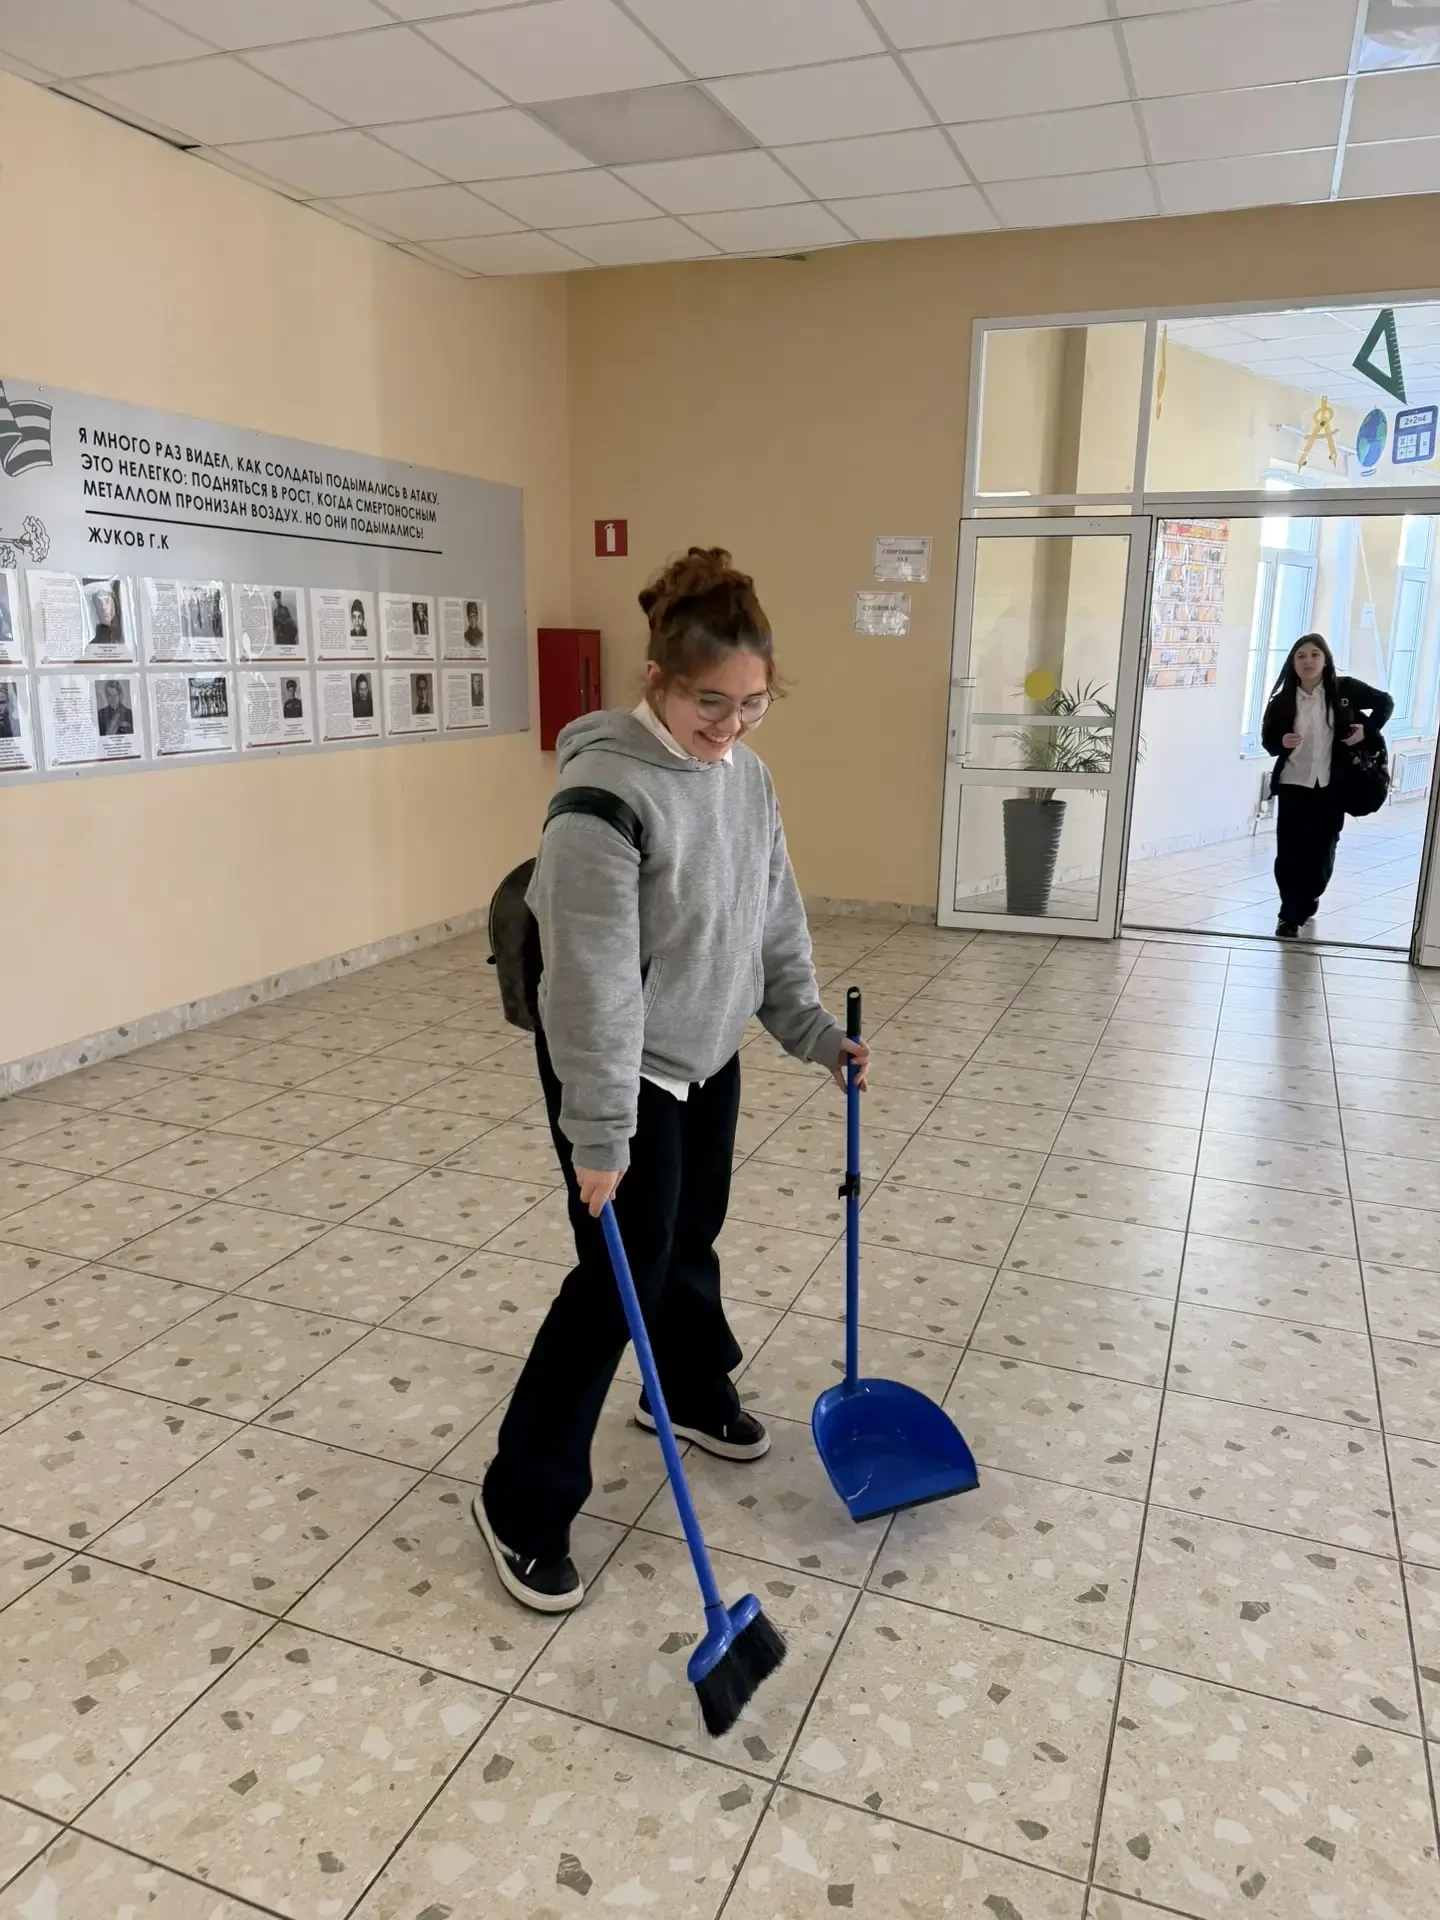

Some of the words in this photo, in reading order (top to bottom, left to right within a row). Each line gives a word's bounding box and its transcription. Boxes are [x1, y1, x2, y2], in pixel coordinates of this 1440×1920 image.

[1404, 415, 1426, 425] 2+2=4
[79, 427, 87, 444] Я
[93, 430, 150, 455] МНОГО
[156, 441, 182, 460] РАЗ
[186, 447, 233, 471] ВИДЕЛ,
[237, 457, 261, 475] КАК
[265, 462, 323, 485] СОЛДАТЫ
[326, 473, 400, 497] ПОДЫМАЛИСЬ
[402, 487, 408, 499] В
[81, 453, 113, 473] ЭТО
[119, 459, 188, 485] НЕЛЕГКО:
[192, 472, 268, 497] ПОДНЯТЬСЯ
[271, 485, 278, 499] В
[281, 487, 314, 506] РОСТ,
[317, 492, 353, 510] КОГДА
[356, 499, 437, 523] СМЕРТОНОСНЫМ
[83, 479, 172, 506] МЕТАЛЛОМ
[176, 492, 247, 516] ПРОНИЗАН
[251, 504, 302, 524] ВОЗДУХ.
[305, 511, 322, 526] НО
[325, 514, 348, 529] ОНИ
[350, 518, 424, 540] ПОДЫМАЛИСЬ!
[88, 526, 145, 548] ЖУКОВ
[149, 533, 170, 550] Г.К
